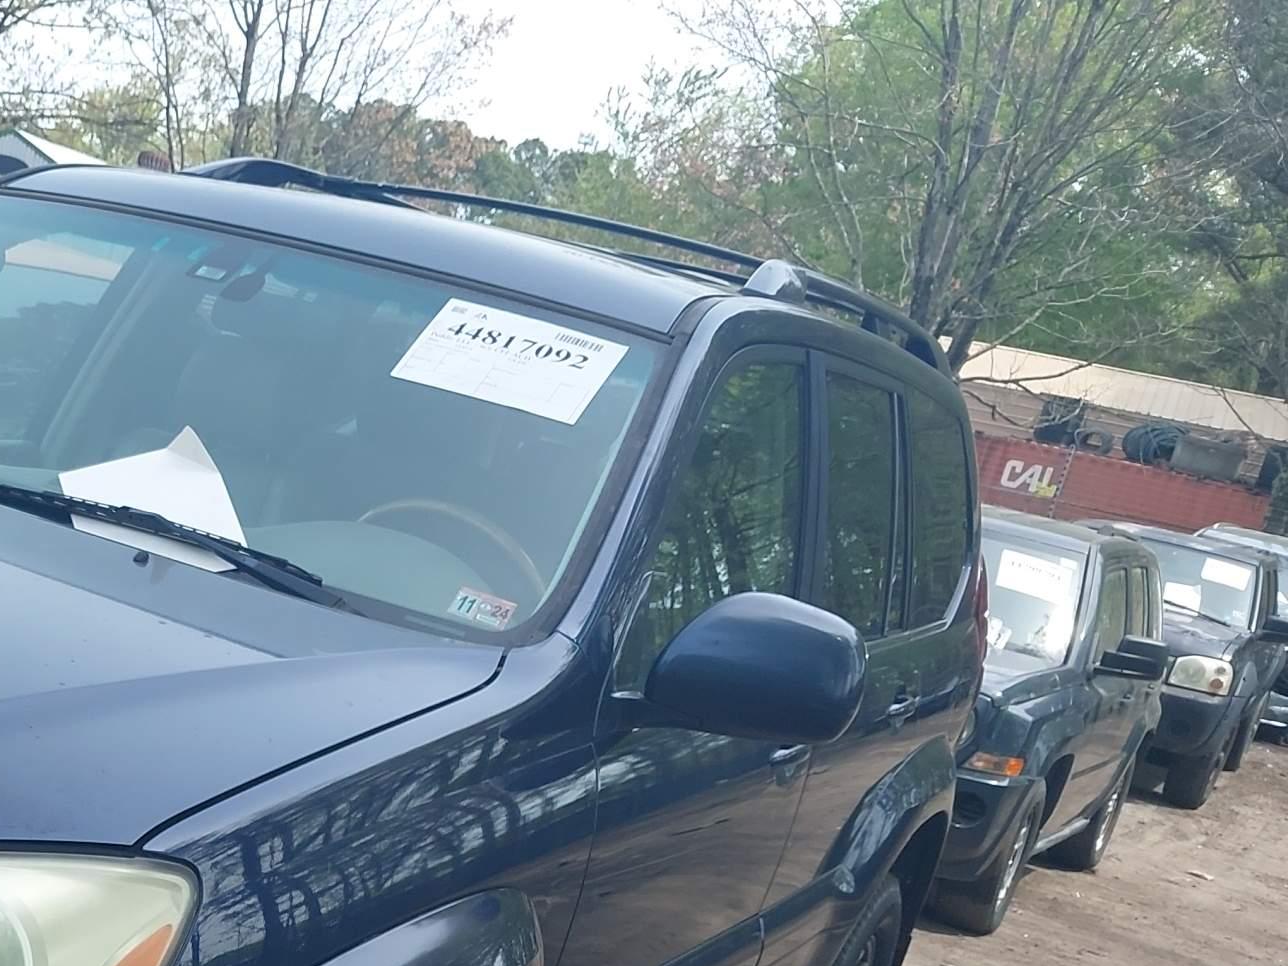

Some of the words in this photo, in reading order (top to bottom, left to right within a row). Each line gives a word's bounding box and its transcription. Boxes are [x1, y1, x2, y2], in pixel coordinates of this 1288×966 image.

[447, 322, 589, 370] 44817092
[1000, 459, 1057, 498] CAL
[457, 595, 477, 614] 11
[491, 605, 511, 620] 24
